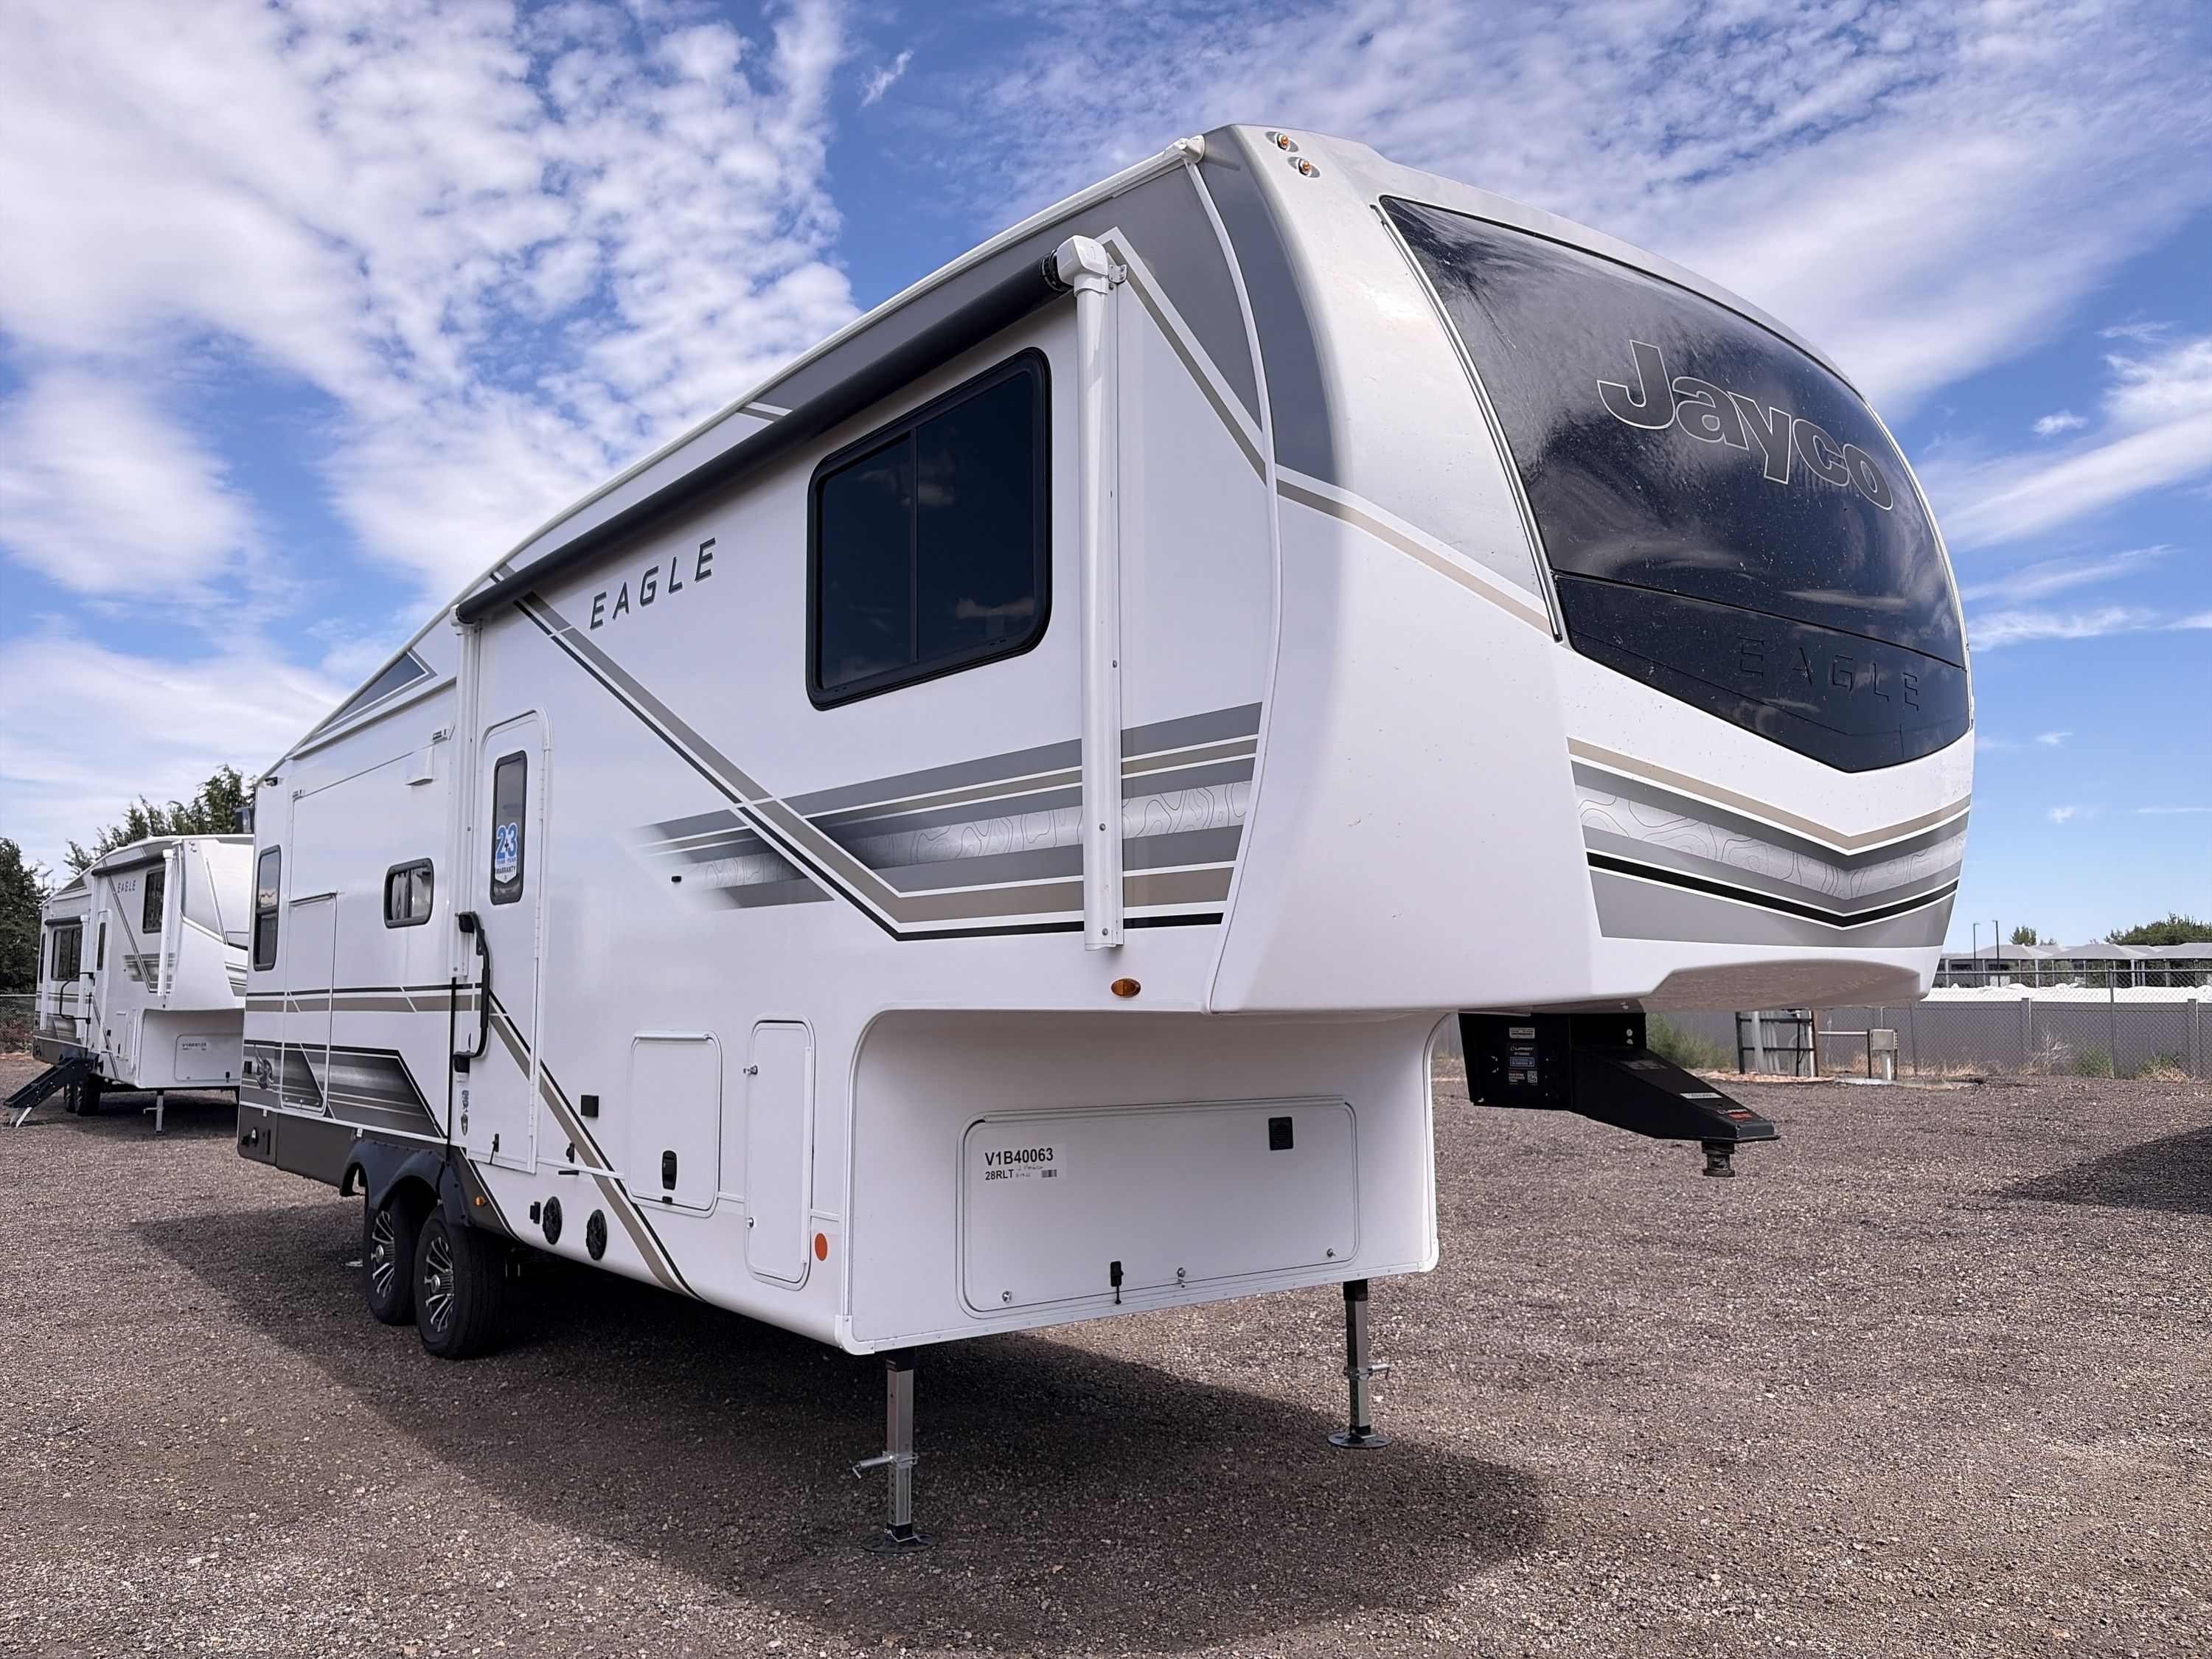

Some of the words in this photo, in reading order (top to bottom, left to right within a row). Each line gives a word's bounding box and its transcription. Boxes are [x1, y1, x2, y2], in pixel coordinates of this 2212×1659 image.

[1596, 339, 1893, 511] Jayco
[589, 537, 717, 631] EAGLE
[1736, 636, 1919, 712] EAGLE
[495, 865, 516, 874] WARRANTY
[117, 879, 136, 894] EAGLE
[984, 1147, 1054, 1166] V1B40063
[984, 1169, 1015, 1180] 28RLT
